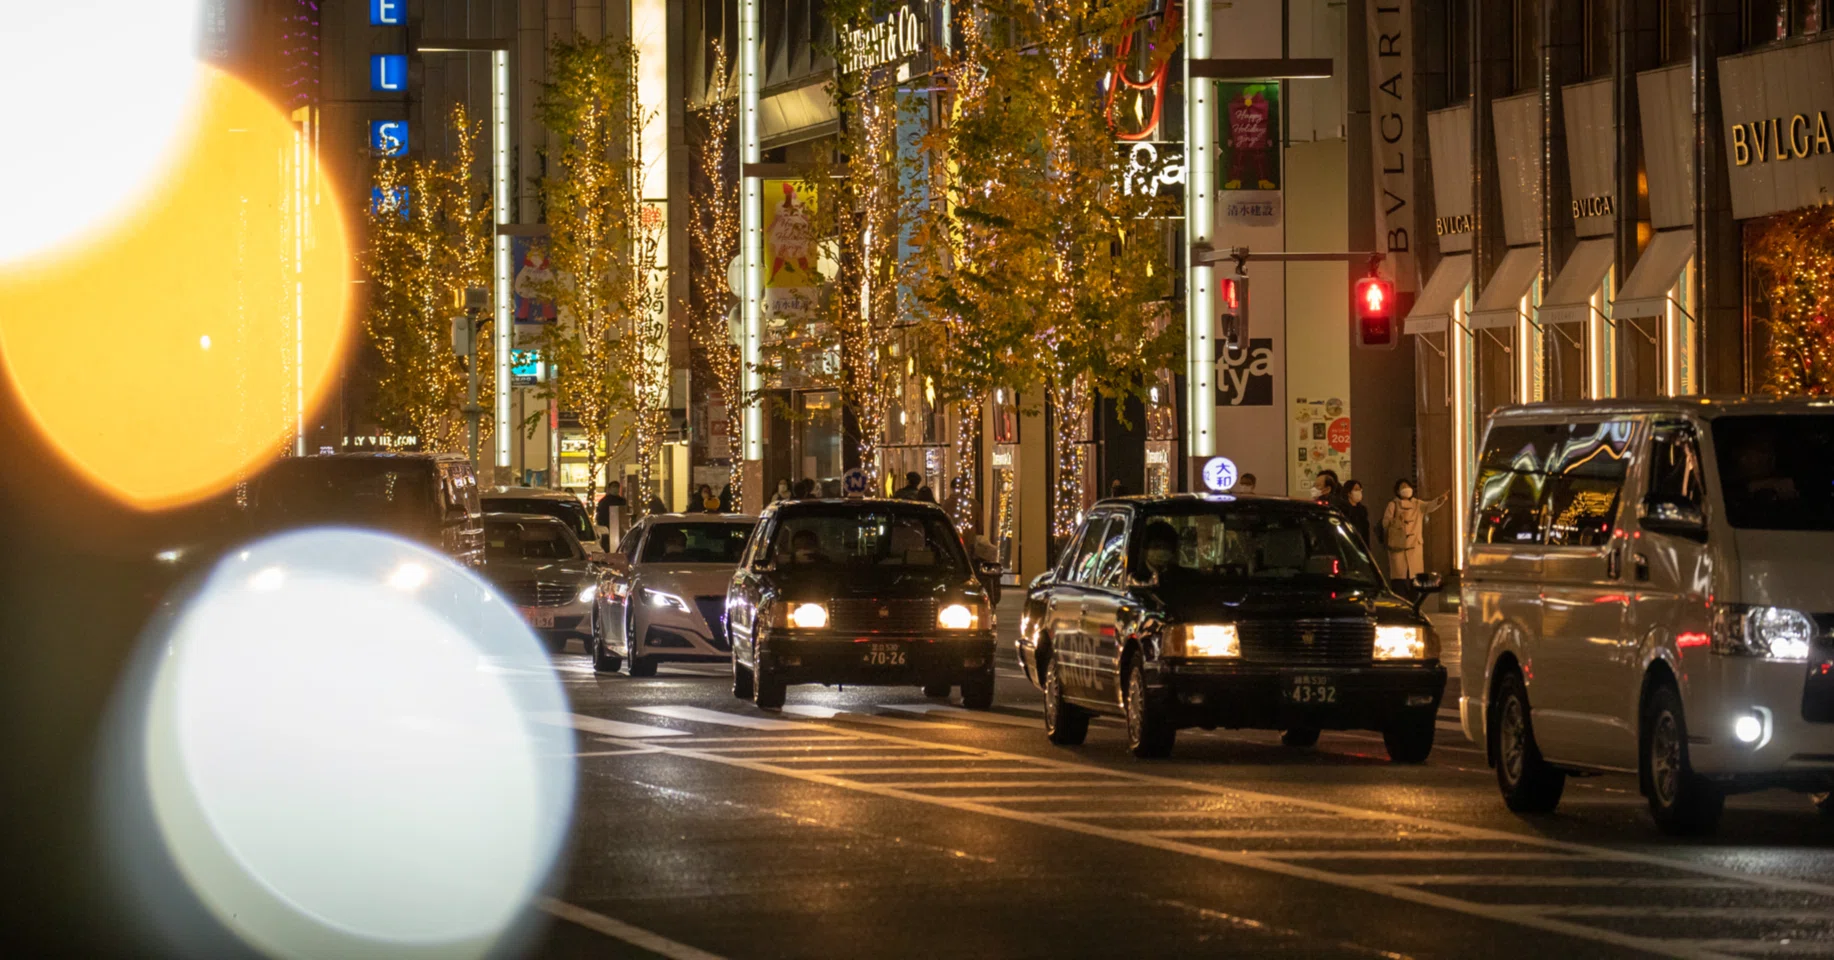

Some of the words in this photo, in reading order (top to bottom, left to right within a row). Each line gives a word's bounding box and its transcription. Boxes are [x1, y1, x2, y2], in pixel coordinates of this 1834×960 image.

[1377, 7, 1409, 253] BVLGARI
[1732, 111, 1832, 166] BVLGA
[1227, 204, 1273, 217] 清水建設
[1215, 463, 1232, 487] 大和
[870, 652, 905, 665] 70-26
[1292, 686, 1336, 702] 43-92
